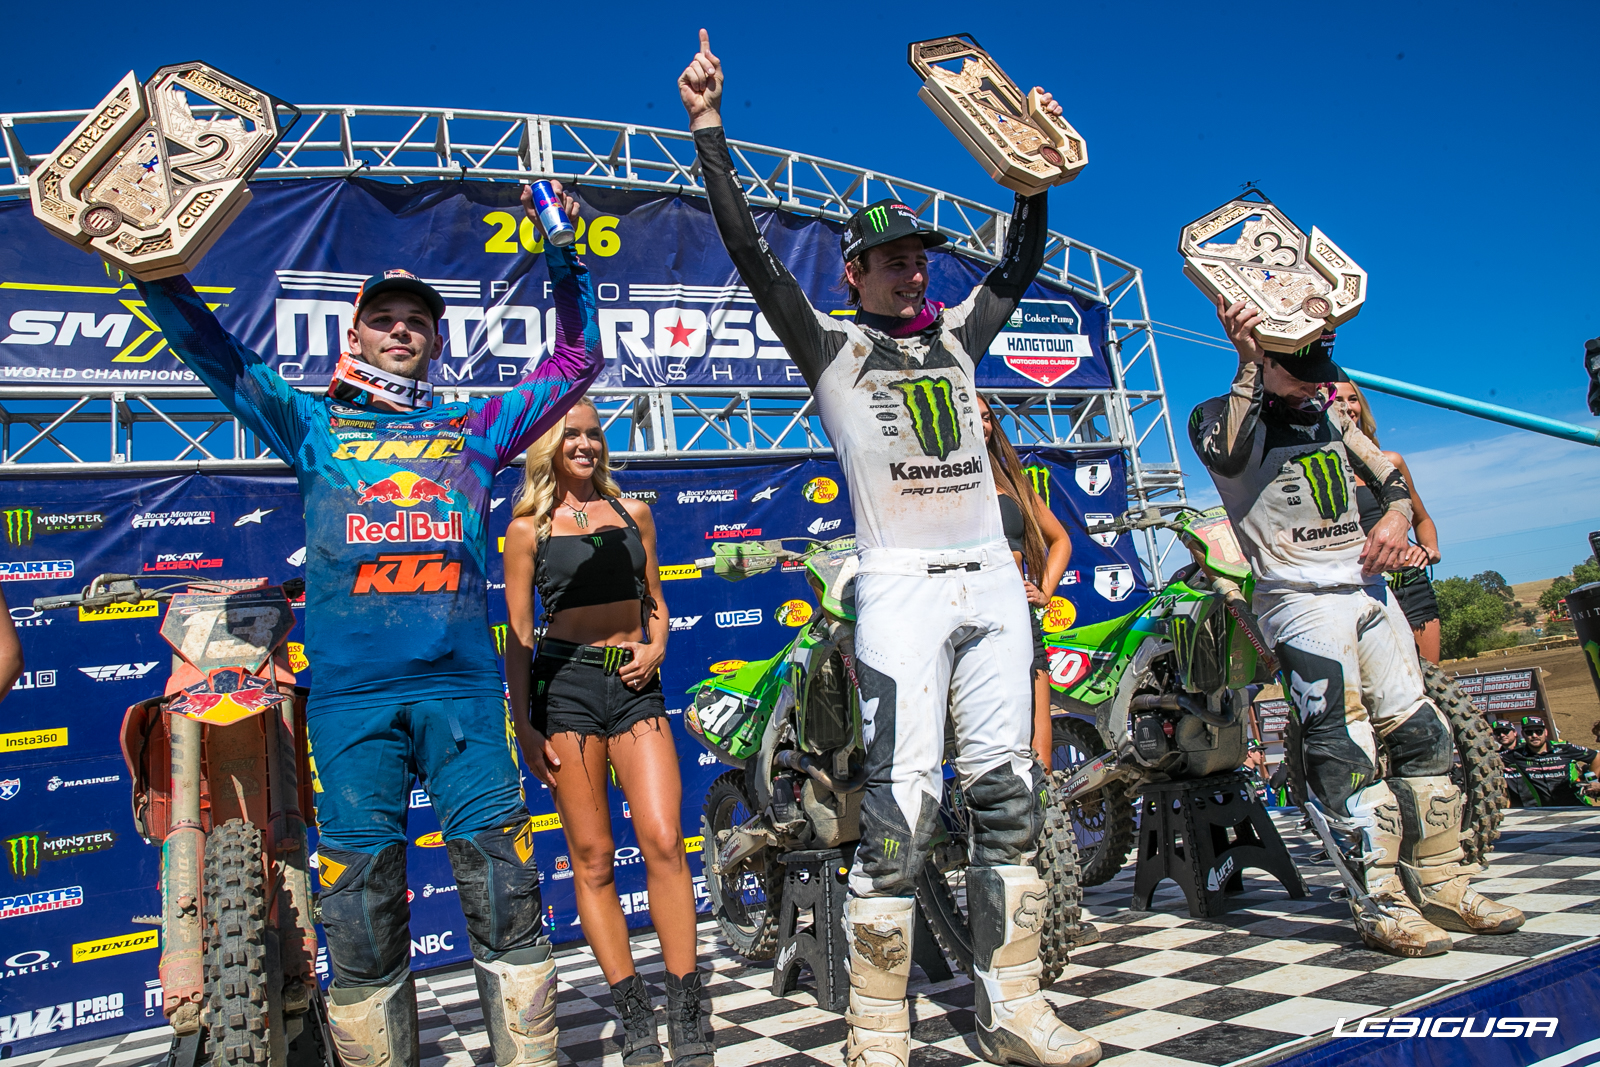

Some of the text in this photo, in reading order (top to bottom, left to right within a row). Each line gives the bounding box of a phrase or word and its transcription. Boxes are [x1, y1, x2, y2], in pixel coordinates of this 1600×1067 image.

[1024, 313, 1074, 326] Coker Pump
[1007, 337, 1074, 352] HANGTOWN
[1010, 358, 1049, 366] MOTOCROSS
[4, 366, 77, 380] WORLD
[346, 368, 431, 401] SCOTT
[889, 455, 983, 481] Kawasaki
[817, 478, 831, 487] Bass
[900, 481, 982, 496] PRO CIRCUIT
[817, 492, 836, 501] Shops
[347, 511, 463, 543] Red Bull
[714, 523, 748, 532] MX-ATV
[704, 528, 762, 540] LEGENDS
[157, 552, 204, 562] MX-ATV
[0, 561, 73, 574] PARTS
[143, 558, 224, 572] LEGENDS
[352, 553, 462, 595] KTM
[789, 601, 804, 609] Bass
[1151, 592, 1189, 611] KX
[790, 608, 802, 616] Pro
[716, 611, 763, 627] WPS
[791, 615, 809, 624] Shops
[1049, 616, 1073, 629] Shops
[180, 605, 281, 663] 13
[95, 674, 144, 683] RACING
[1484, 680, 1529, 691] motorsports
[1489, 699, 1534, 710] motorsports
[5, 733, 58, 748] Insta360
[63, 775, 120, 788] MARINES
[43, 832, 113, 850] MONSTER
[53, 844, 102, 856] ENERGY
[556, 860, 569, 870] 66
[0, 886, 82, 910] PARTS
[88, 935, 156, 954] DUNLOP
[410, 931, 454, 958] NBC
[76, 992, 124, 1017] PRO
[75, 1008, 124, 1027] RACING
